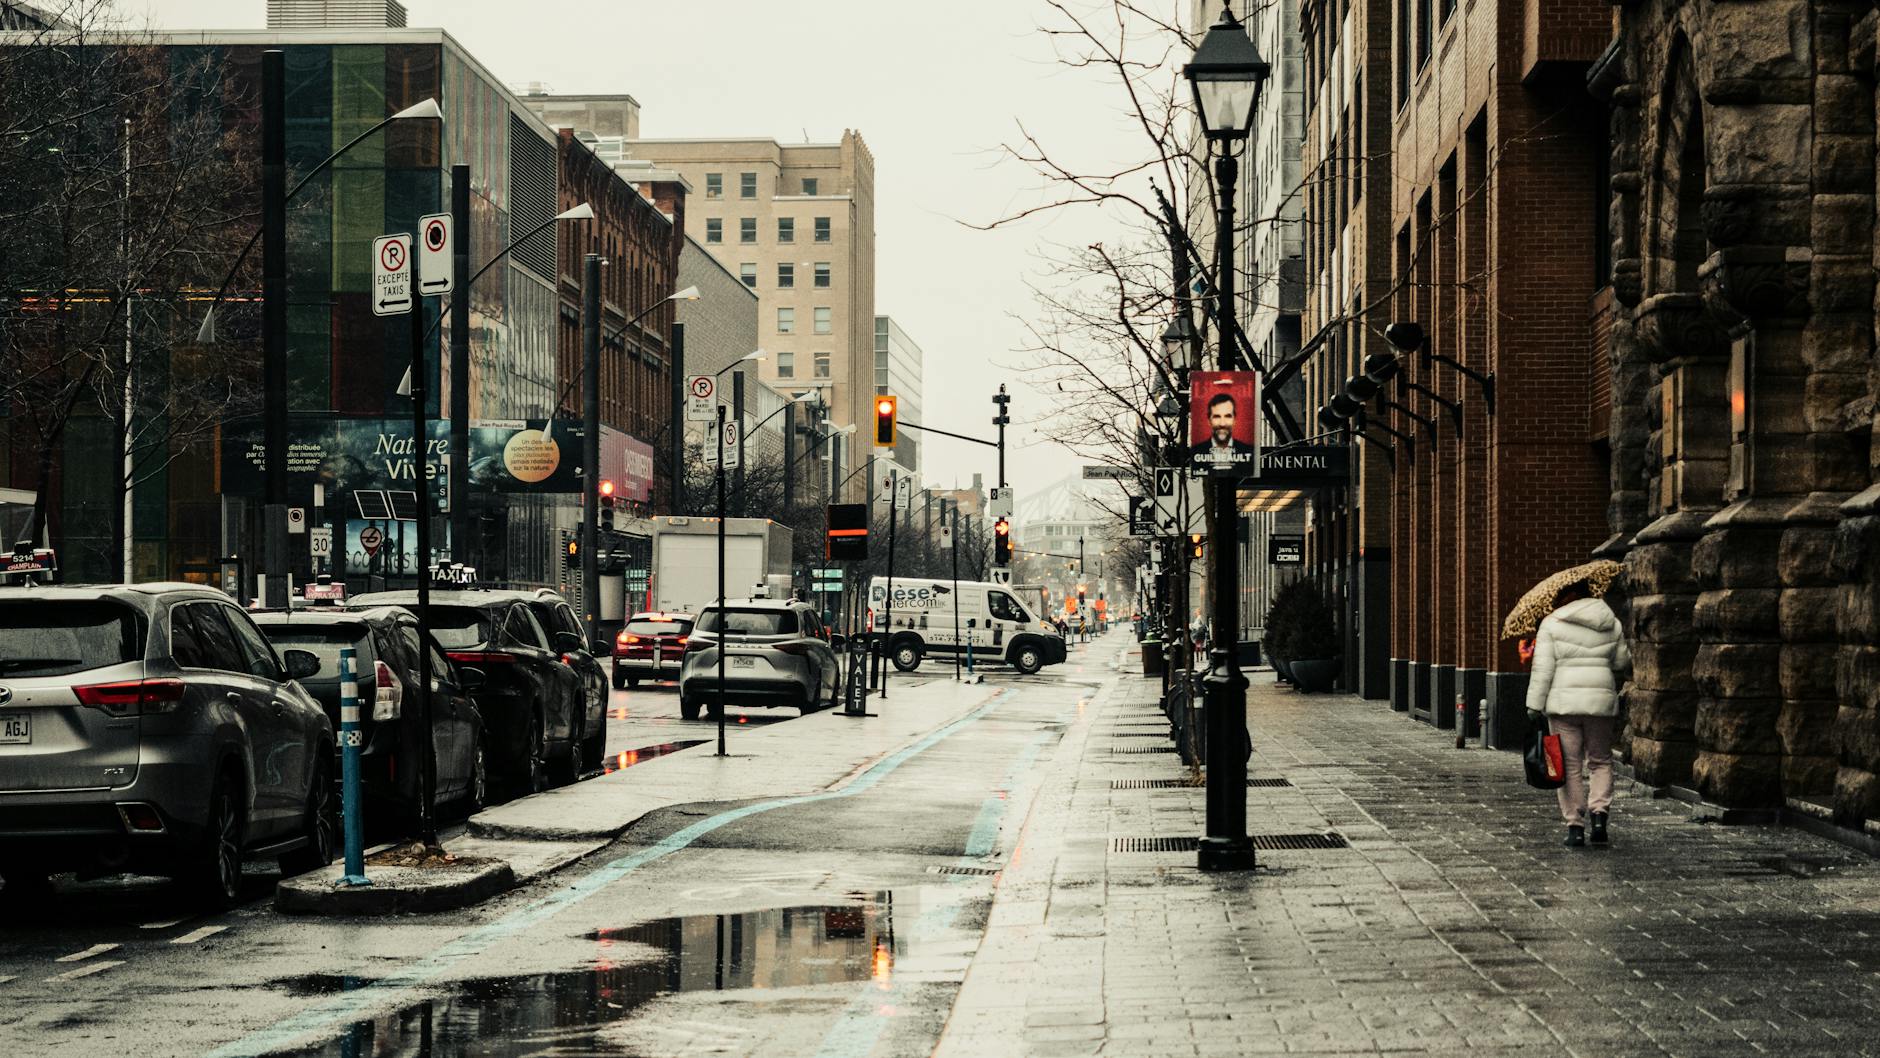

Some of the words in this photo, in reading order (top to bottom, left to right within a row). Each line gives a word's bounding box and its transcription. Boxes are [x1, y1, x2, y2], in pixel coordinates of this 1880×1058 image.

[378, 269, 408, 285] EXCEPTÉ
[384, 285, 404, 297] TAXIS
[374, 434, 449, 454] Natre
[1194, 453, 1251, 462] GUILBEAULT
[1261, 456, 1328, 468] TINENTAL
[313, 538, 328, 552] 30
[429, 569, 460, 580] TAXI
[872, 584, 929, 602] Dèse
[881, 599, 937, 608] Itercom
[854, 655, 863, 709] VALET
[5, 721, 28, 736] AGJ
